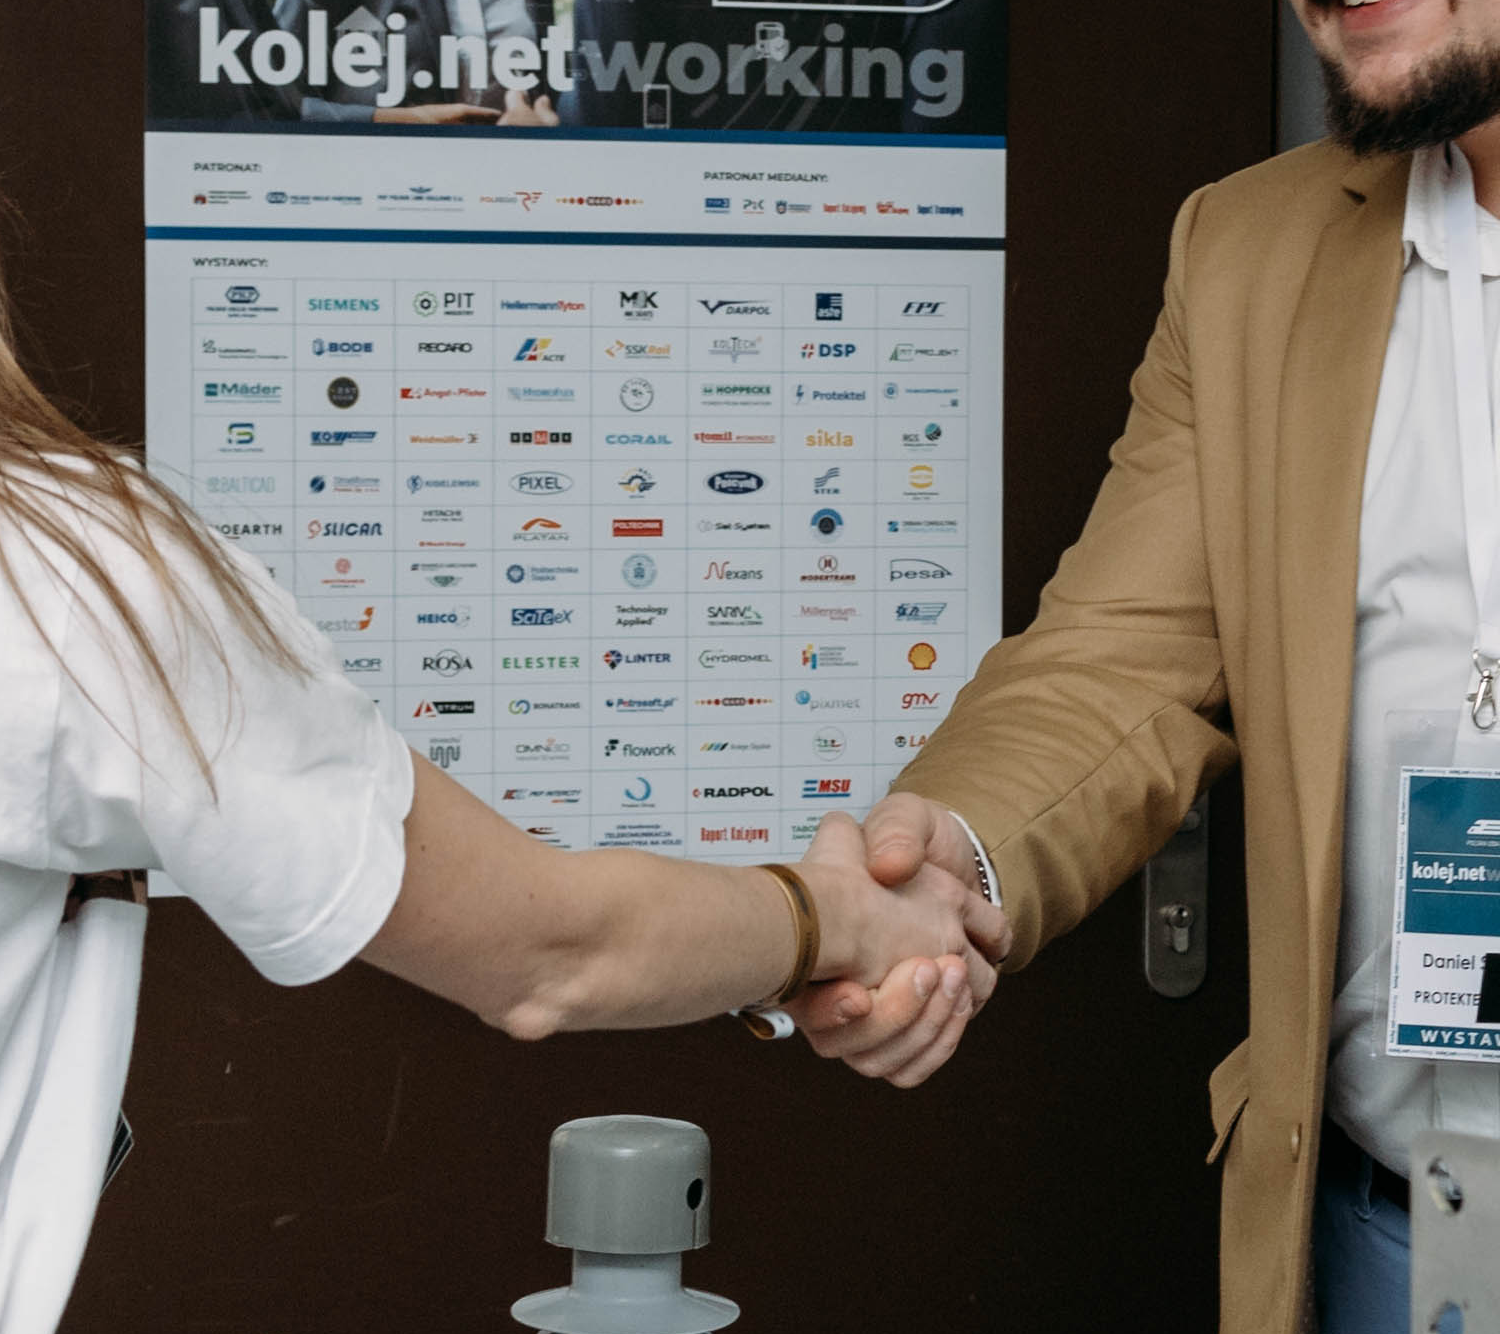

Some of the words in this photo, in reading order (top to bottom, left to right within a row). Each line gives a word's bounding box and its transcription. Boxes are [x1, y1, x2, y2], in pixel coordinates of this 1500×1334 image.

[199, 7, 965, 119] kolej.networking
[194, 163, 262, 173] PATRONAT:
[704, 171, 764, 182] PATRONAT
[767, 173, 828, 183] MEDIALNY:
[193, 257, 269, 268] WYSTAWCY:
[308, 298, 380, 312] SIEMENS
[444, 292, 476, 308] PIT
[501, 300, 586, 312] HellermannTyton
[725, 306, 771, 316] DARPOL
[328, 342, 374, 353] BODE
[418, 342, 473, 353] RECARO
[818, 344, 856, 357] DSP
[220, 383, 282, 395] Mäder
[812, 390, 866, 401] Protektel
[605, 435, 673, 445] CORAIL
[806, 430, 854, 447] sikla
[518, 476, 563, 490] PIXEL
[423, 509, 462, 517] HITACHI
[513, 533, 569, 542] PLATAN
[703, 561, 763, 580] Nexans
[889, 567, 952, 582] pesa
[615, 605, 668, 616] Technology
[417, 613, 458, 624] HEICO
[421, 657, 473, 671] ROSA
[502, 656, 580, 669] ELESTER
[625, 653, 671, 664] LINTER
[901, 692, 941, 710] gmv
[623, 743, 676, 757] flowork
[818, 779, 852, 793] MSU
[704, 787, 774, 798] RADPOL
[700, 827, 728, 843] Raport
[1422, 952, 1474, 970] Daniel
